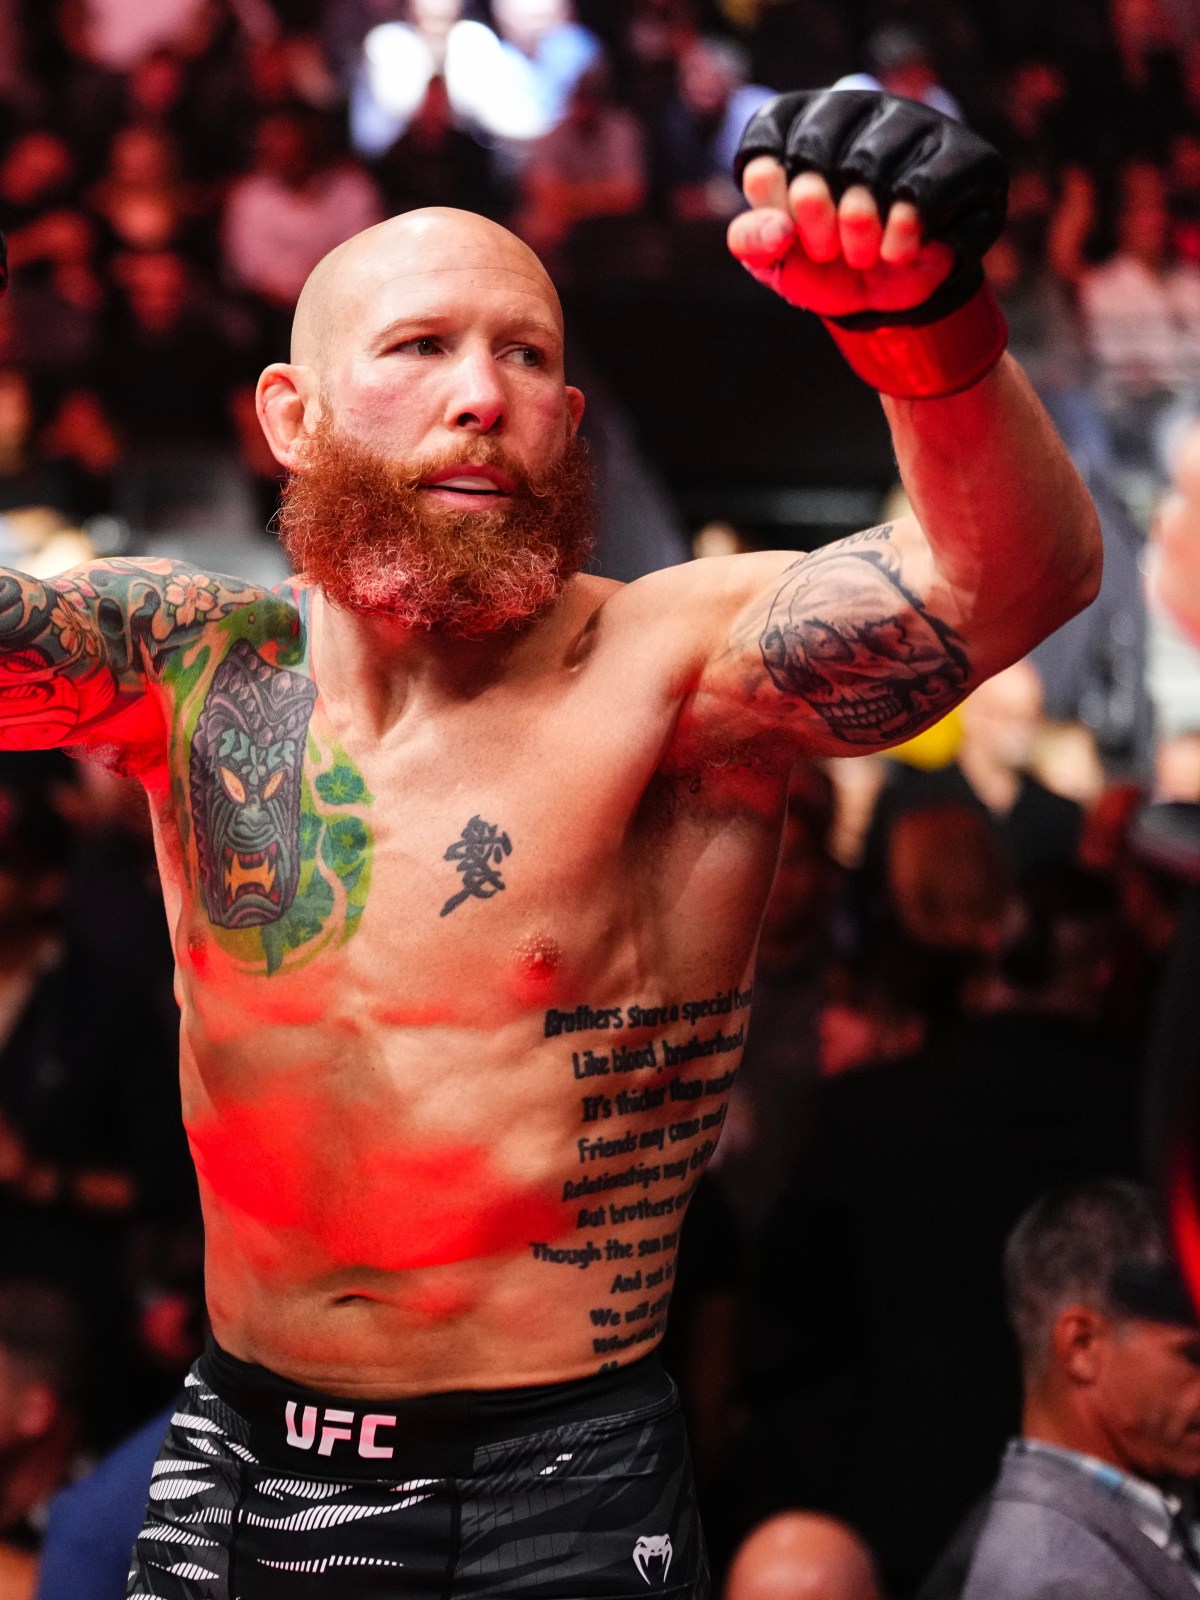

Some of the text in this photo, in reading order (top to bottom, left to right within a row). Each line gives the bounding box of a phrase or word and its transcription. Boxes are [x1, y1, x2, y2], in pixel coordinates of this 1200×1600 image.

[544, 1004, 624, 1038] Brothers
[669, 1004, 679, 1022] a
[682, 988, 732, 1026] special
[572, 1050, 610, 1079] Like
[662, 1023, 744, 1067] brotherhood
[581, 1094, 612, 1122] It's
[615, 1086, 667, 1115] thicker
[669, 1074, 703, 1101] than
[577, 1130, 638, 1163] Friends
[639, 1127, 665, 1150] may
[669, 1118, 700, 1142] come
[561, 1161, 661, 1202] Relationships
[663, 1157, 689, 1181] may
[576, 1205, 605, 1229] But
[610, 1197, 674, 1225] brothers
[528, 1241, 602, 1269] Though
[604, 1238, 634, 1260] the
[610, 1269, 641, 1294] And
[589, 1308, 621, 1327] We
[285, 1400, 397, 1460] UFC
